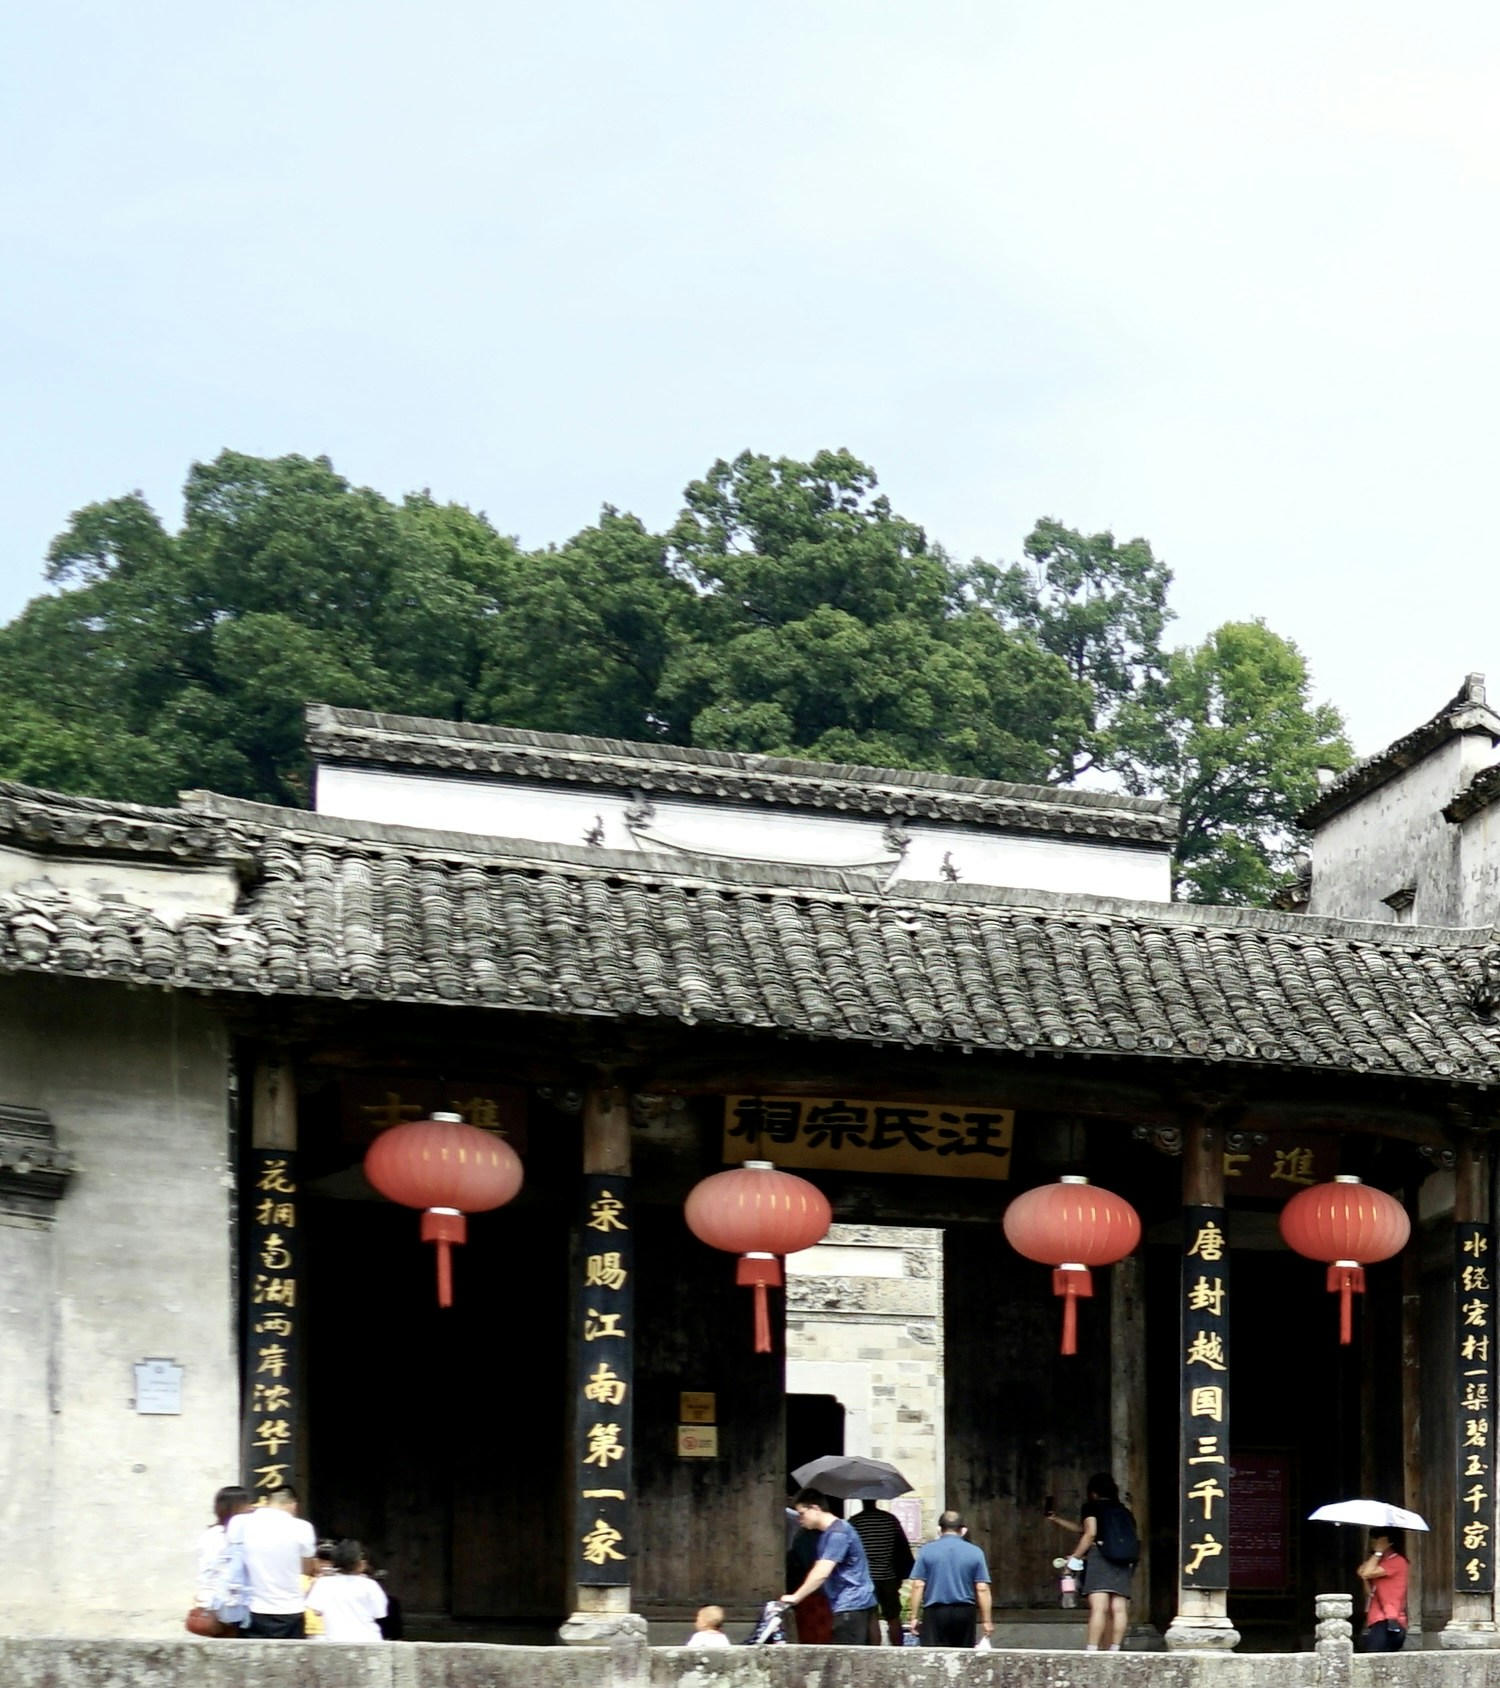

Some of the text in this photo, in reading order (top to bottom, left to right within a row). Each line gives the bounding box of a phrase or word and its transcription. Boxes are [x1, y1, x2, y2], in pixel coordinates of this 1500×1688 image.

[252, 1159, 297, 1507] 花拥南湖两岸浓华万
[583, 1190, 629, 1566] 宋赐江南第一家
[1185, 1221, 1228, 1576] 唐封越国三千户
